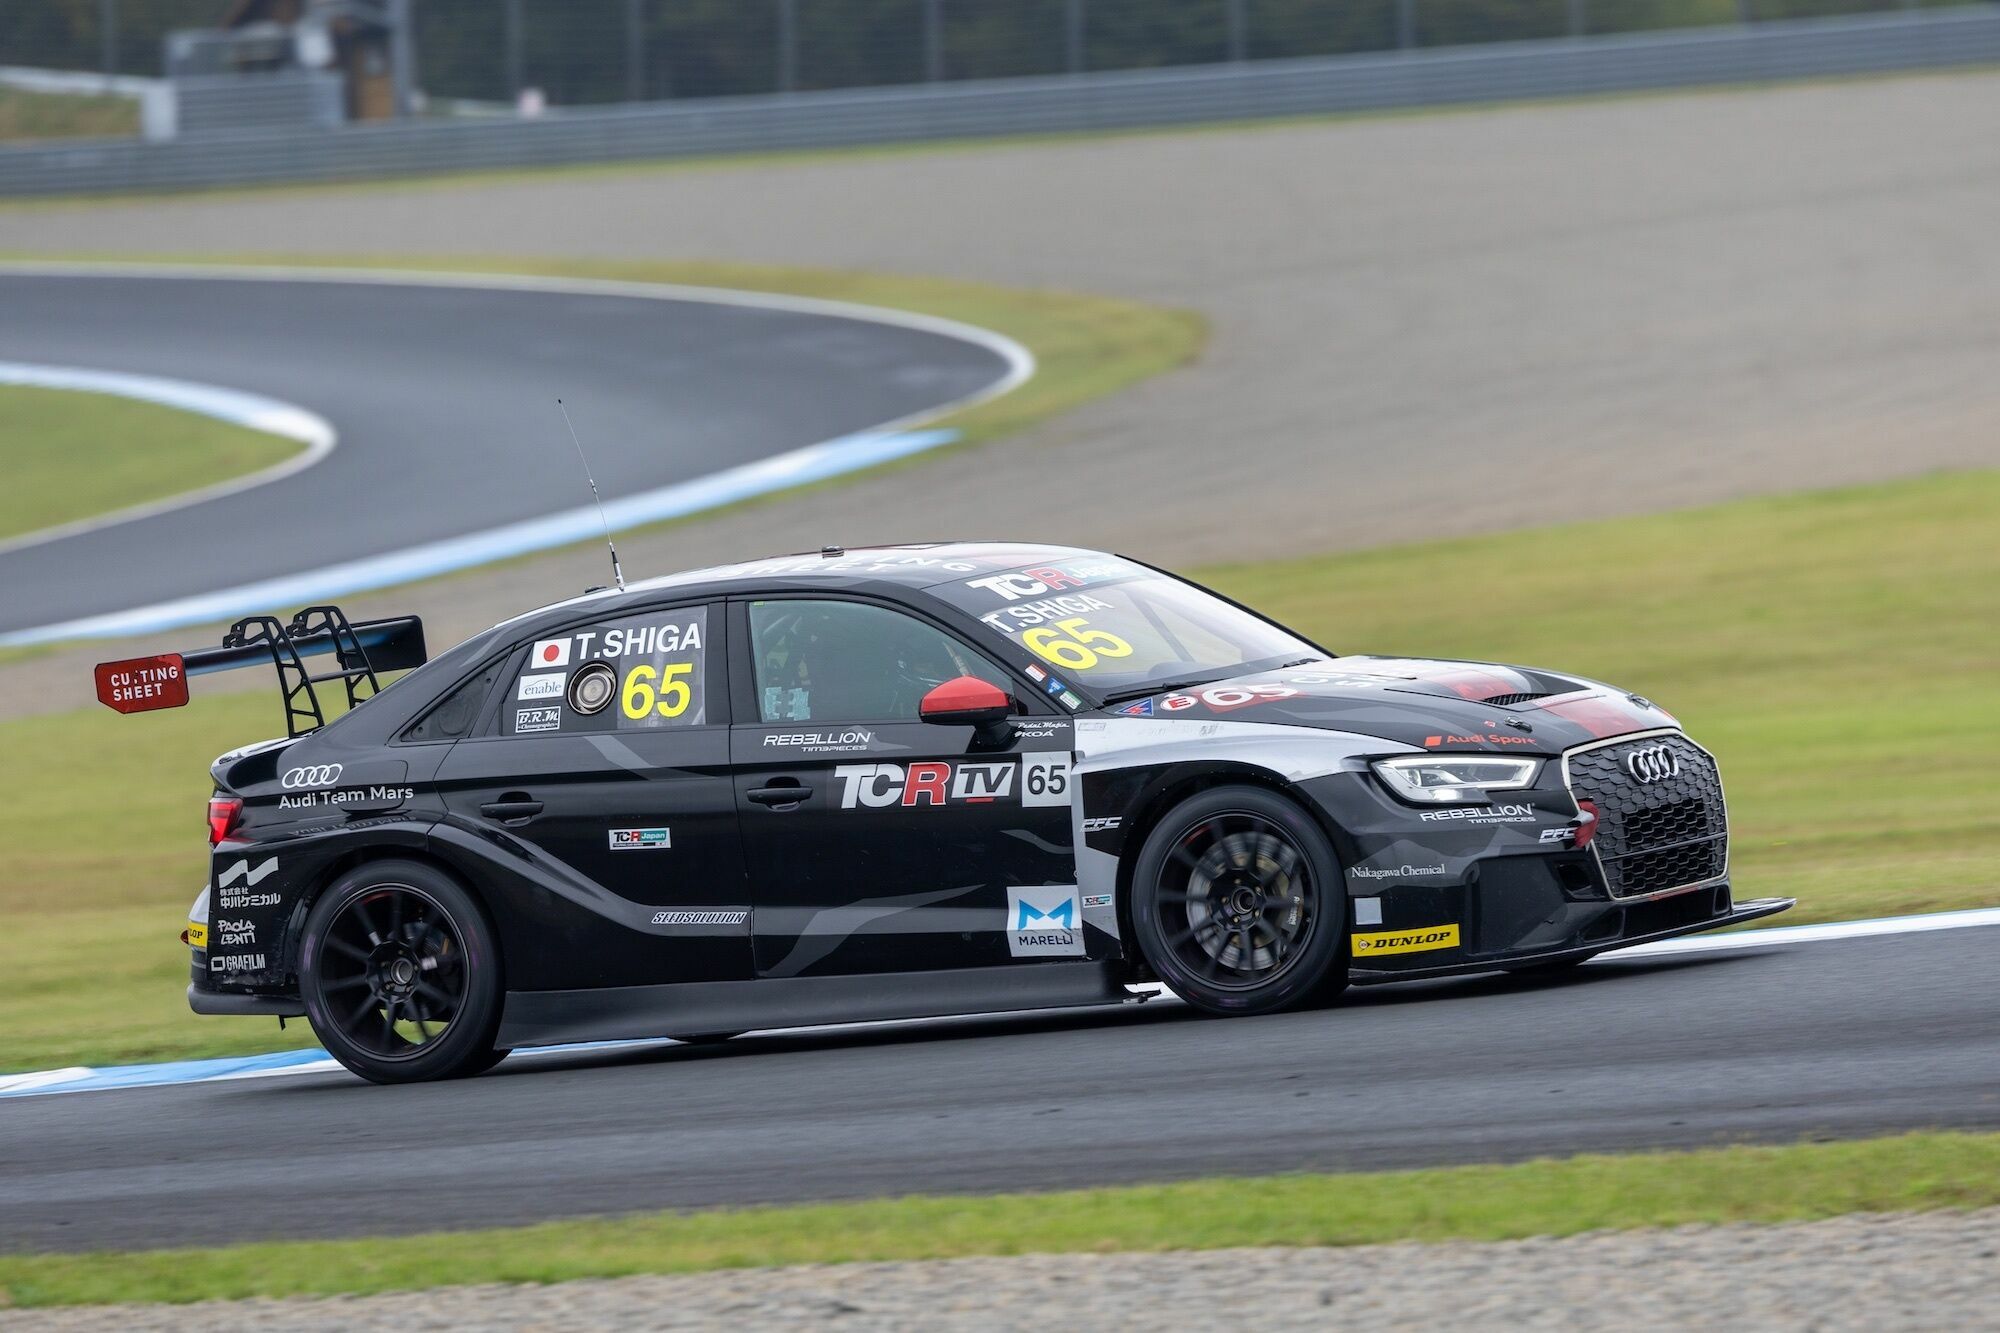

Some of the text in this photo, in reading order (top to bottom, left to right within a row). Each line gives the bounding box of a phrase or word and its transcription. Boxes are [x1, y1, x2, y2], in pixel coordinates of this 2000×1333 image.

[965, 566, 1084, 600] TCR
[980, 594, 1115, 633] T.SHIGA
[575, 623, 701, 660] T.SHIGA
[1022, 618, 1133, 669] 65
[113, 683, 162, 701] SHEET
[524, 680, 561, 695] enable
[621, 663, 693, 720] 65
[1202, 684, 1298, 706] 65
[763, 732, 871, 746] REBELLION
[1447, 734, 1537, 745] Audi Sport
[834, 761, 1012, 809] TCR TV
[1027, 765, 1066, 795] 65
[279, 785, 414, 809] Audi Team Mars
[1420, 803, 1532, 821] REBELLION
[1081, 816, 1122, 828] PFC
[614, 831, 665, 842] TCR Japan
[1351, 864, 1446, 880] Nakagawa Chemical
[220, 893, 281, 909] 中川ケミカル
[1018, 935, 1074, 946] MARELLI
[1373, 931, 1452, 948] DUNLOP
[226, 953, 265, 971] GRAFILM
